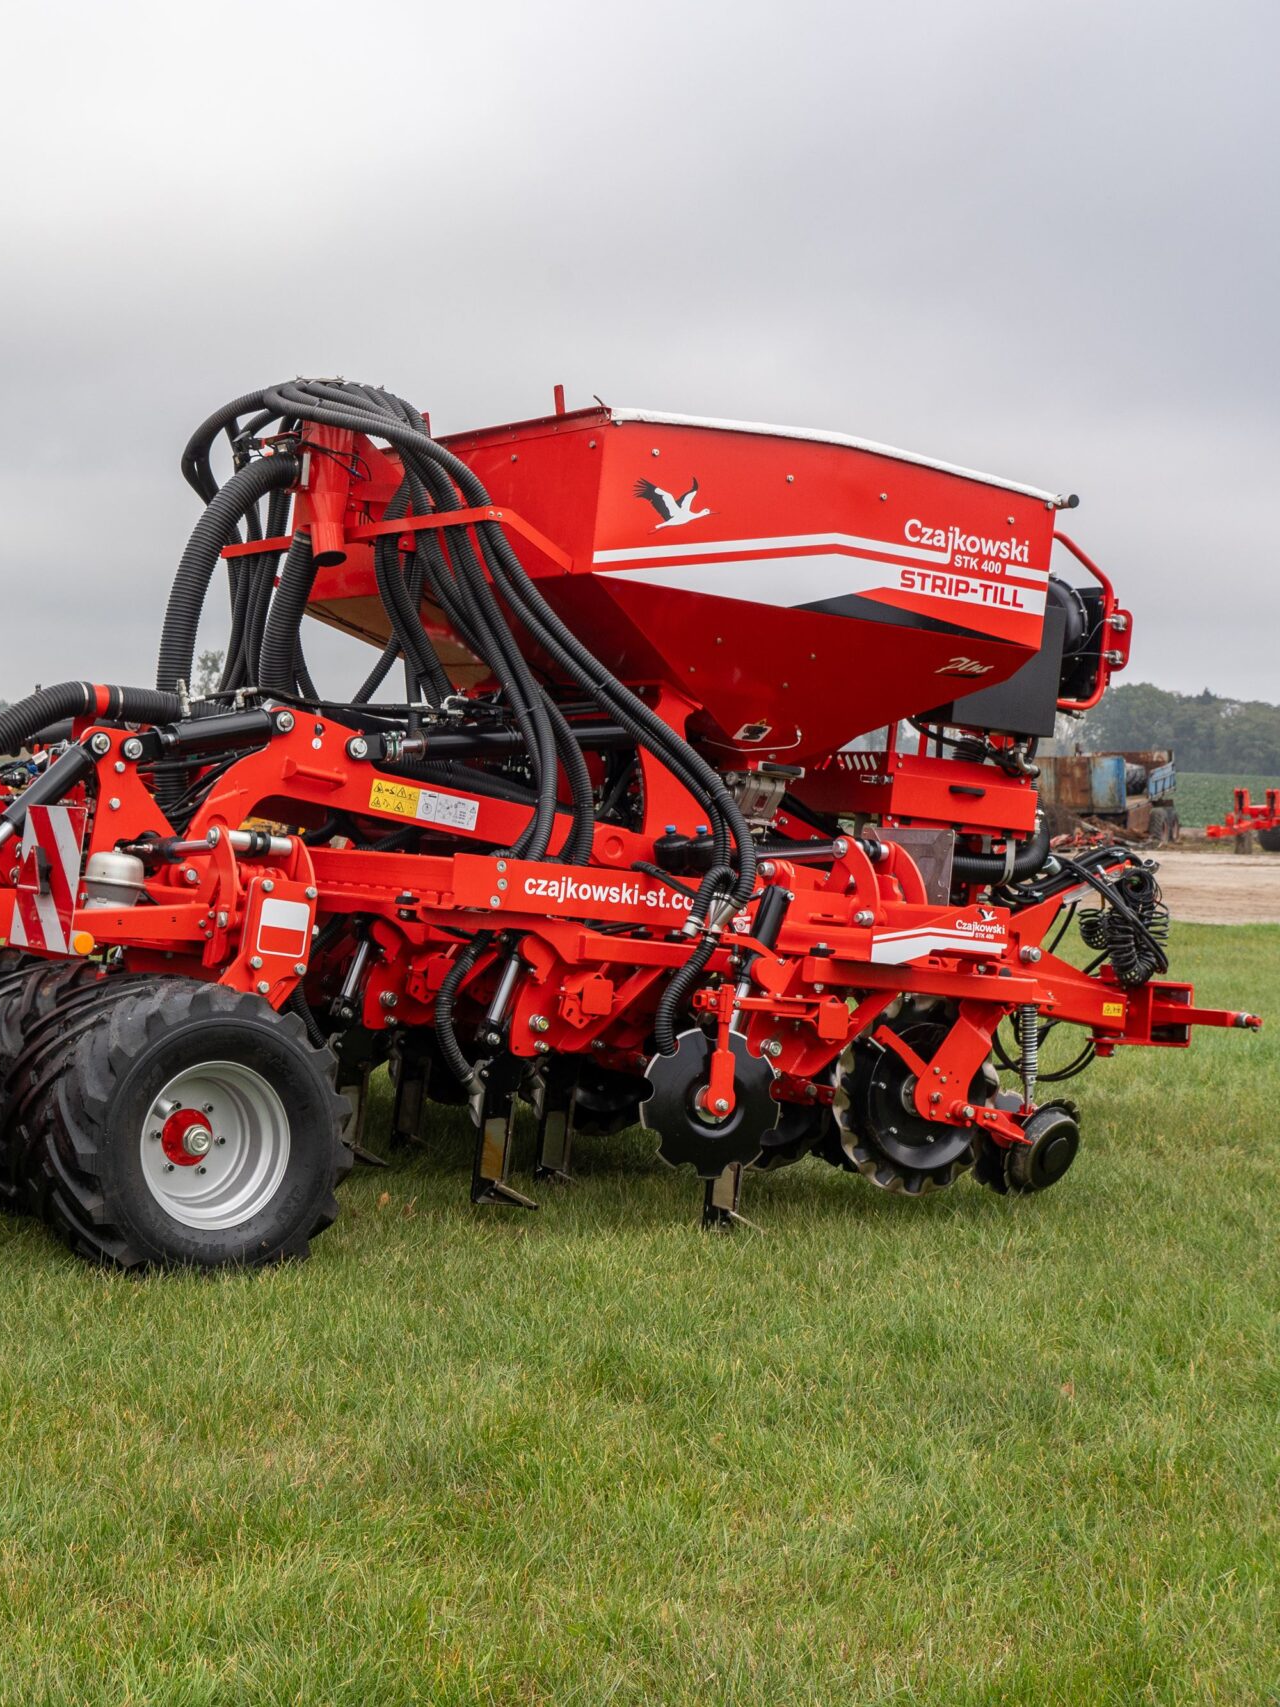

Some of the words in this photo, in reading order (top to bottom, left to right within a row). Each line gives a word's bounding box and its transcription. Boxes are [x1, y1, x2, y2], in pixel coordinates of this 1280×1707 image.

[904, 518, 1030, 563] Czajkowski
[953, 554, 979, 570] STK
[981, 560, 1002, 574] 400
[900, 569, 1024, 609] STRIP-TILL
[524, 876, 695, 911] czajkowski-st.co
[955, 919, 1006, 936] Czajkowski
